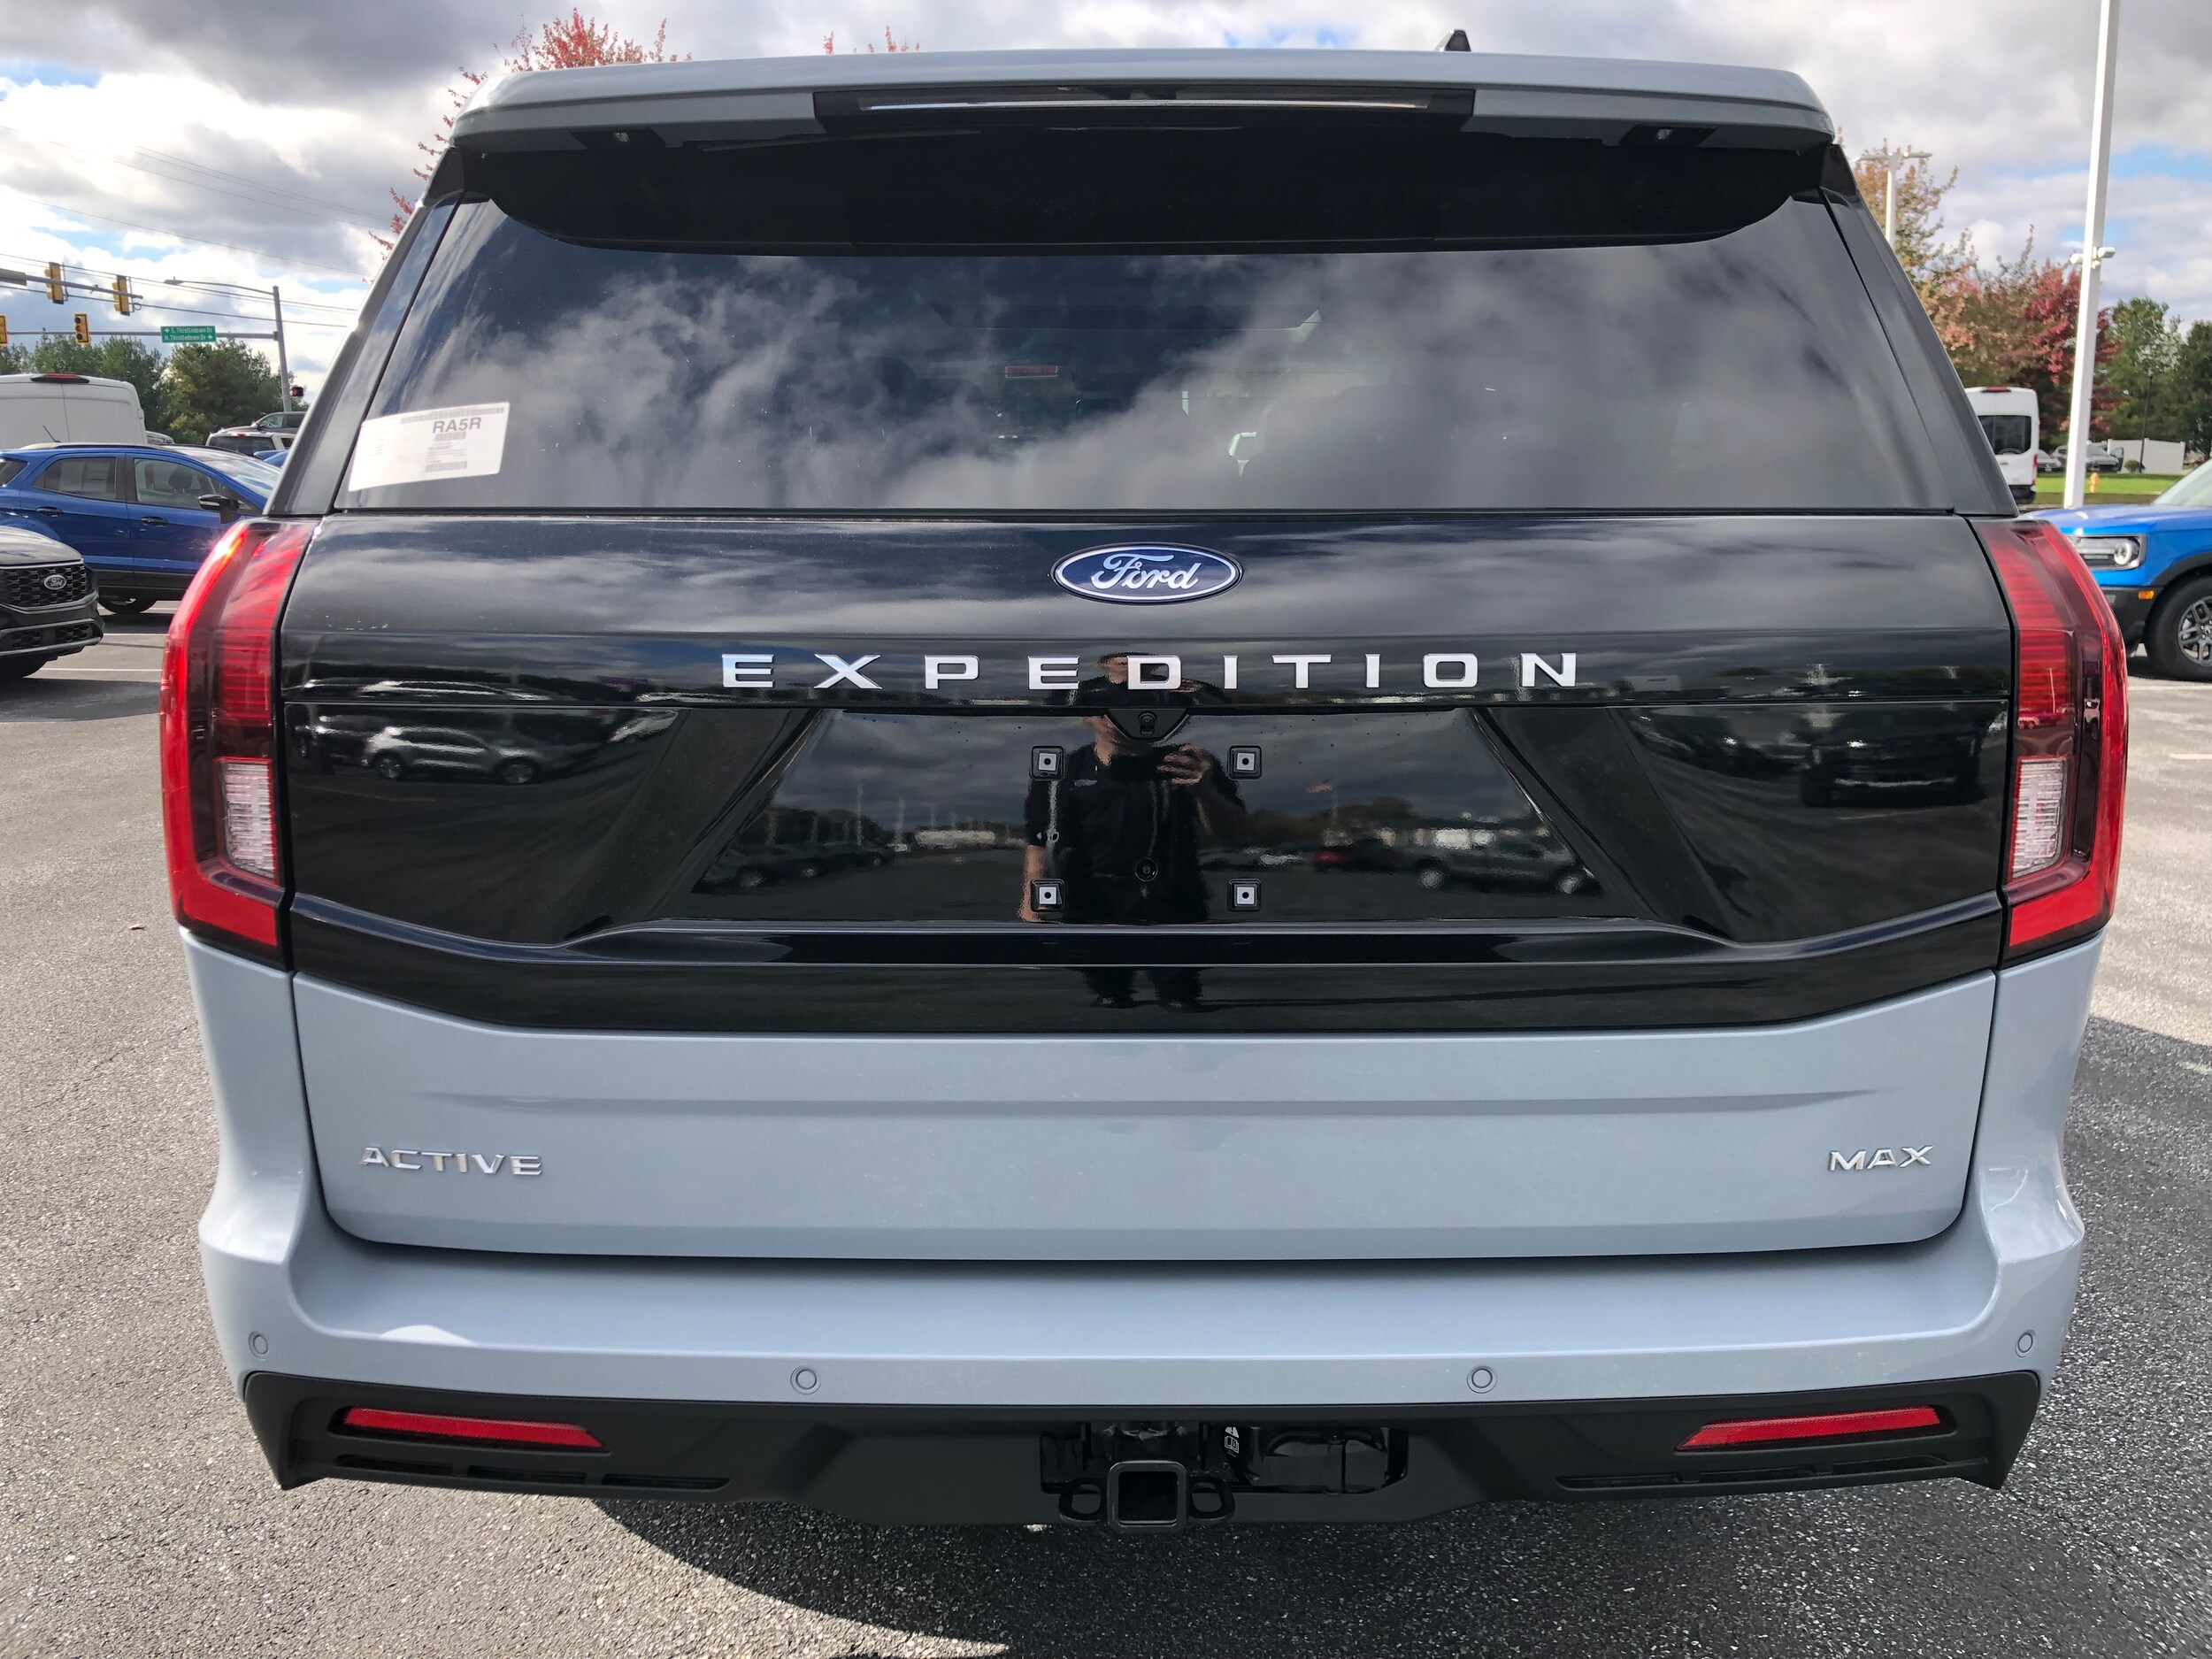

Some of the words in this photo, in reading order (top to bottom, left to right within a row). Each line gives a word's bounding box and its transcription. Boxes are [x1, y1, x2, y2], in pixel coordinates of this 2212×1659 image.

[432, 417, 482, 434] RA5R
[1090, 553, 1202, 589] Ford
[720, 651, 1578, 691] EXPEDITION
[358, 1147, 542, 1176] ACTIVE
[1828, 1145, 1934, 1171] MAX
